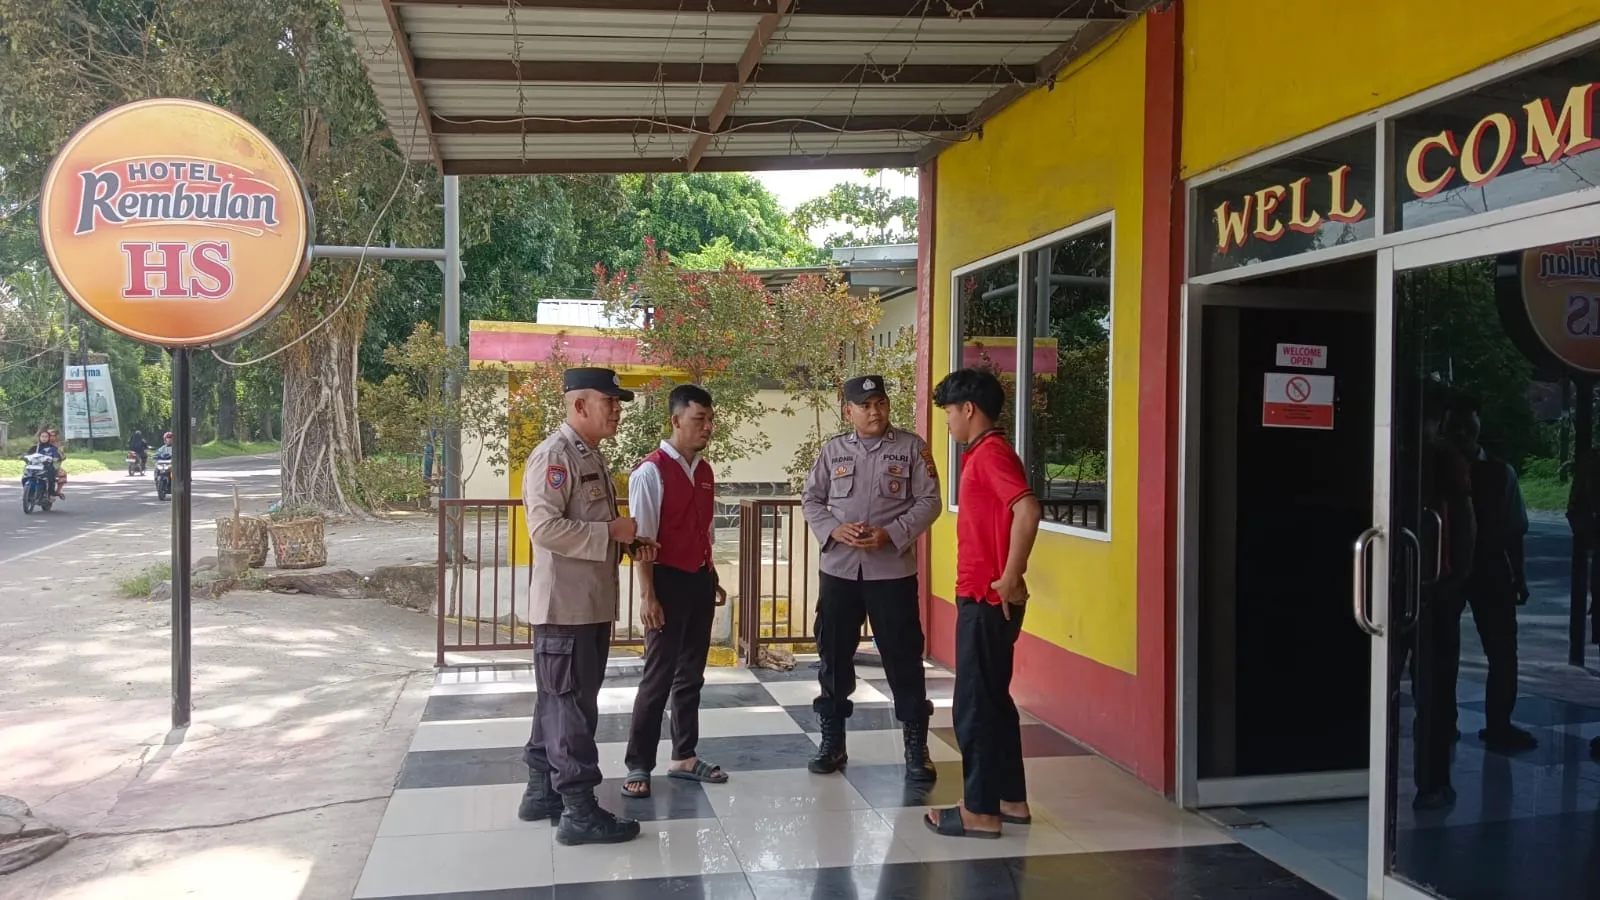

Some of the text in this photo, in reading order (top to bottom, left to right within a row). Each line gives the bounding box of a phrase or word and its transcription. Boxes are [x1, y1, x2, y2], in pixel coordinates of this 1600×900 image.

[127, 162, 223, 183] HOTEL
[74, 170, 280, 235] Rembulan
[1213, 164, 1367, 254] WELL
[121, 241, 233, 298] HS
[1283, 346, 1322, 357] WELCOME
[1290, 356, 1313, 366] OPEN
[883, 454, 908, 462] POLRI
